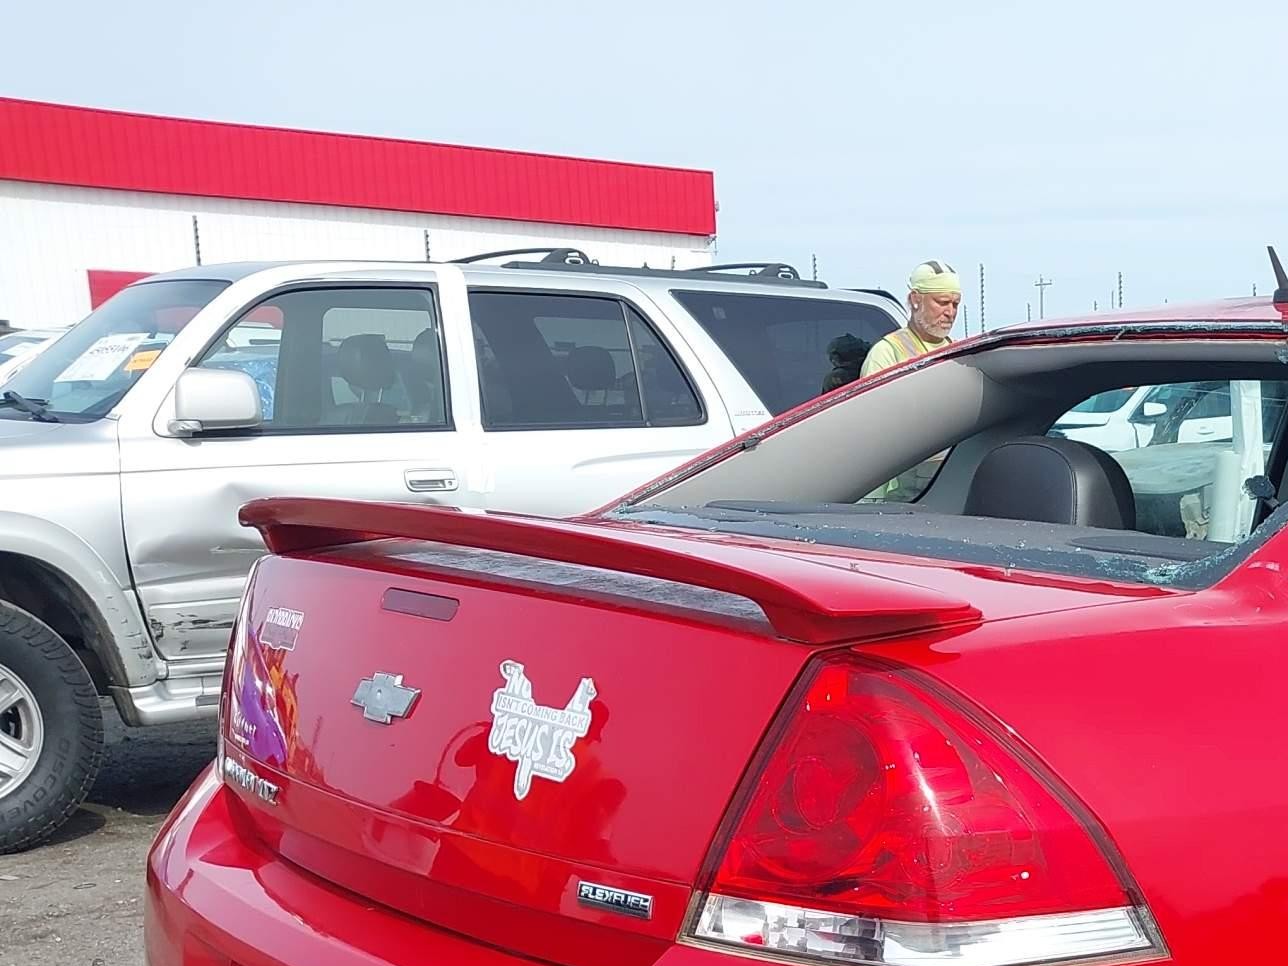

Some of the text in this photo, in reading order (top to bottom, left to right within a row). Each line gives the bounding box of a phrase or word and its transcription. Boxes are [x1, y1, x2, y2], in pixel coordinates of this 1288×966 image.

[521, 702, 557, 722] COMING
[559, 711, 585, 729] BACK
[491, 714, 549, 761] JESUS
